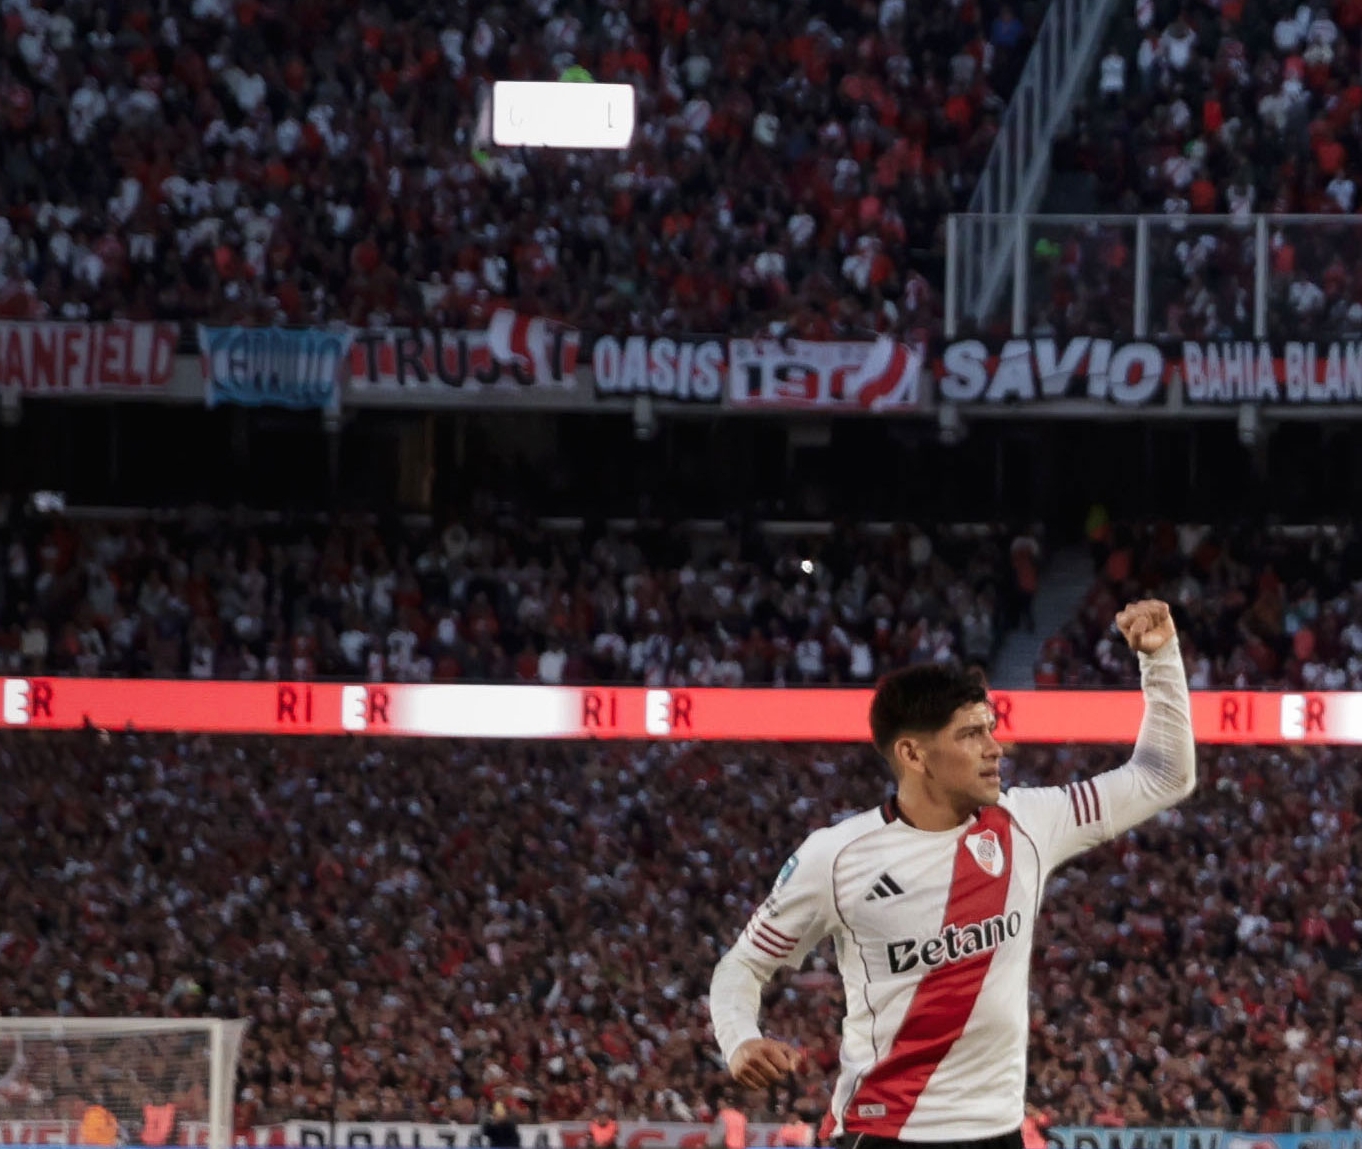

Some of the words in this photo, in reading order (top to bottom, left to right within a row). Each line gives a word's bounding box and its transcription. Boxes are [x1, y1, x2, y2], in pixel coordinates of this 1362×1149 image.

[593, 334, 723, 400] OASIS
[939, 336, 1164, 404] SAVIO
[1183, 341, 1279, 402] BAHIA
[887, 907, 1022, 976] Betano
